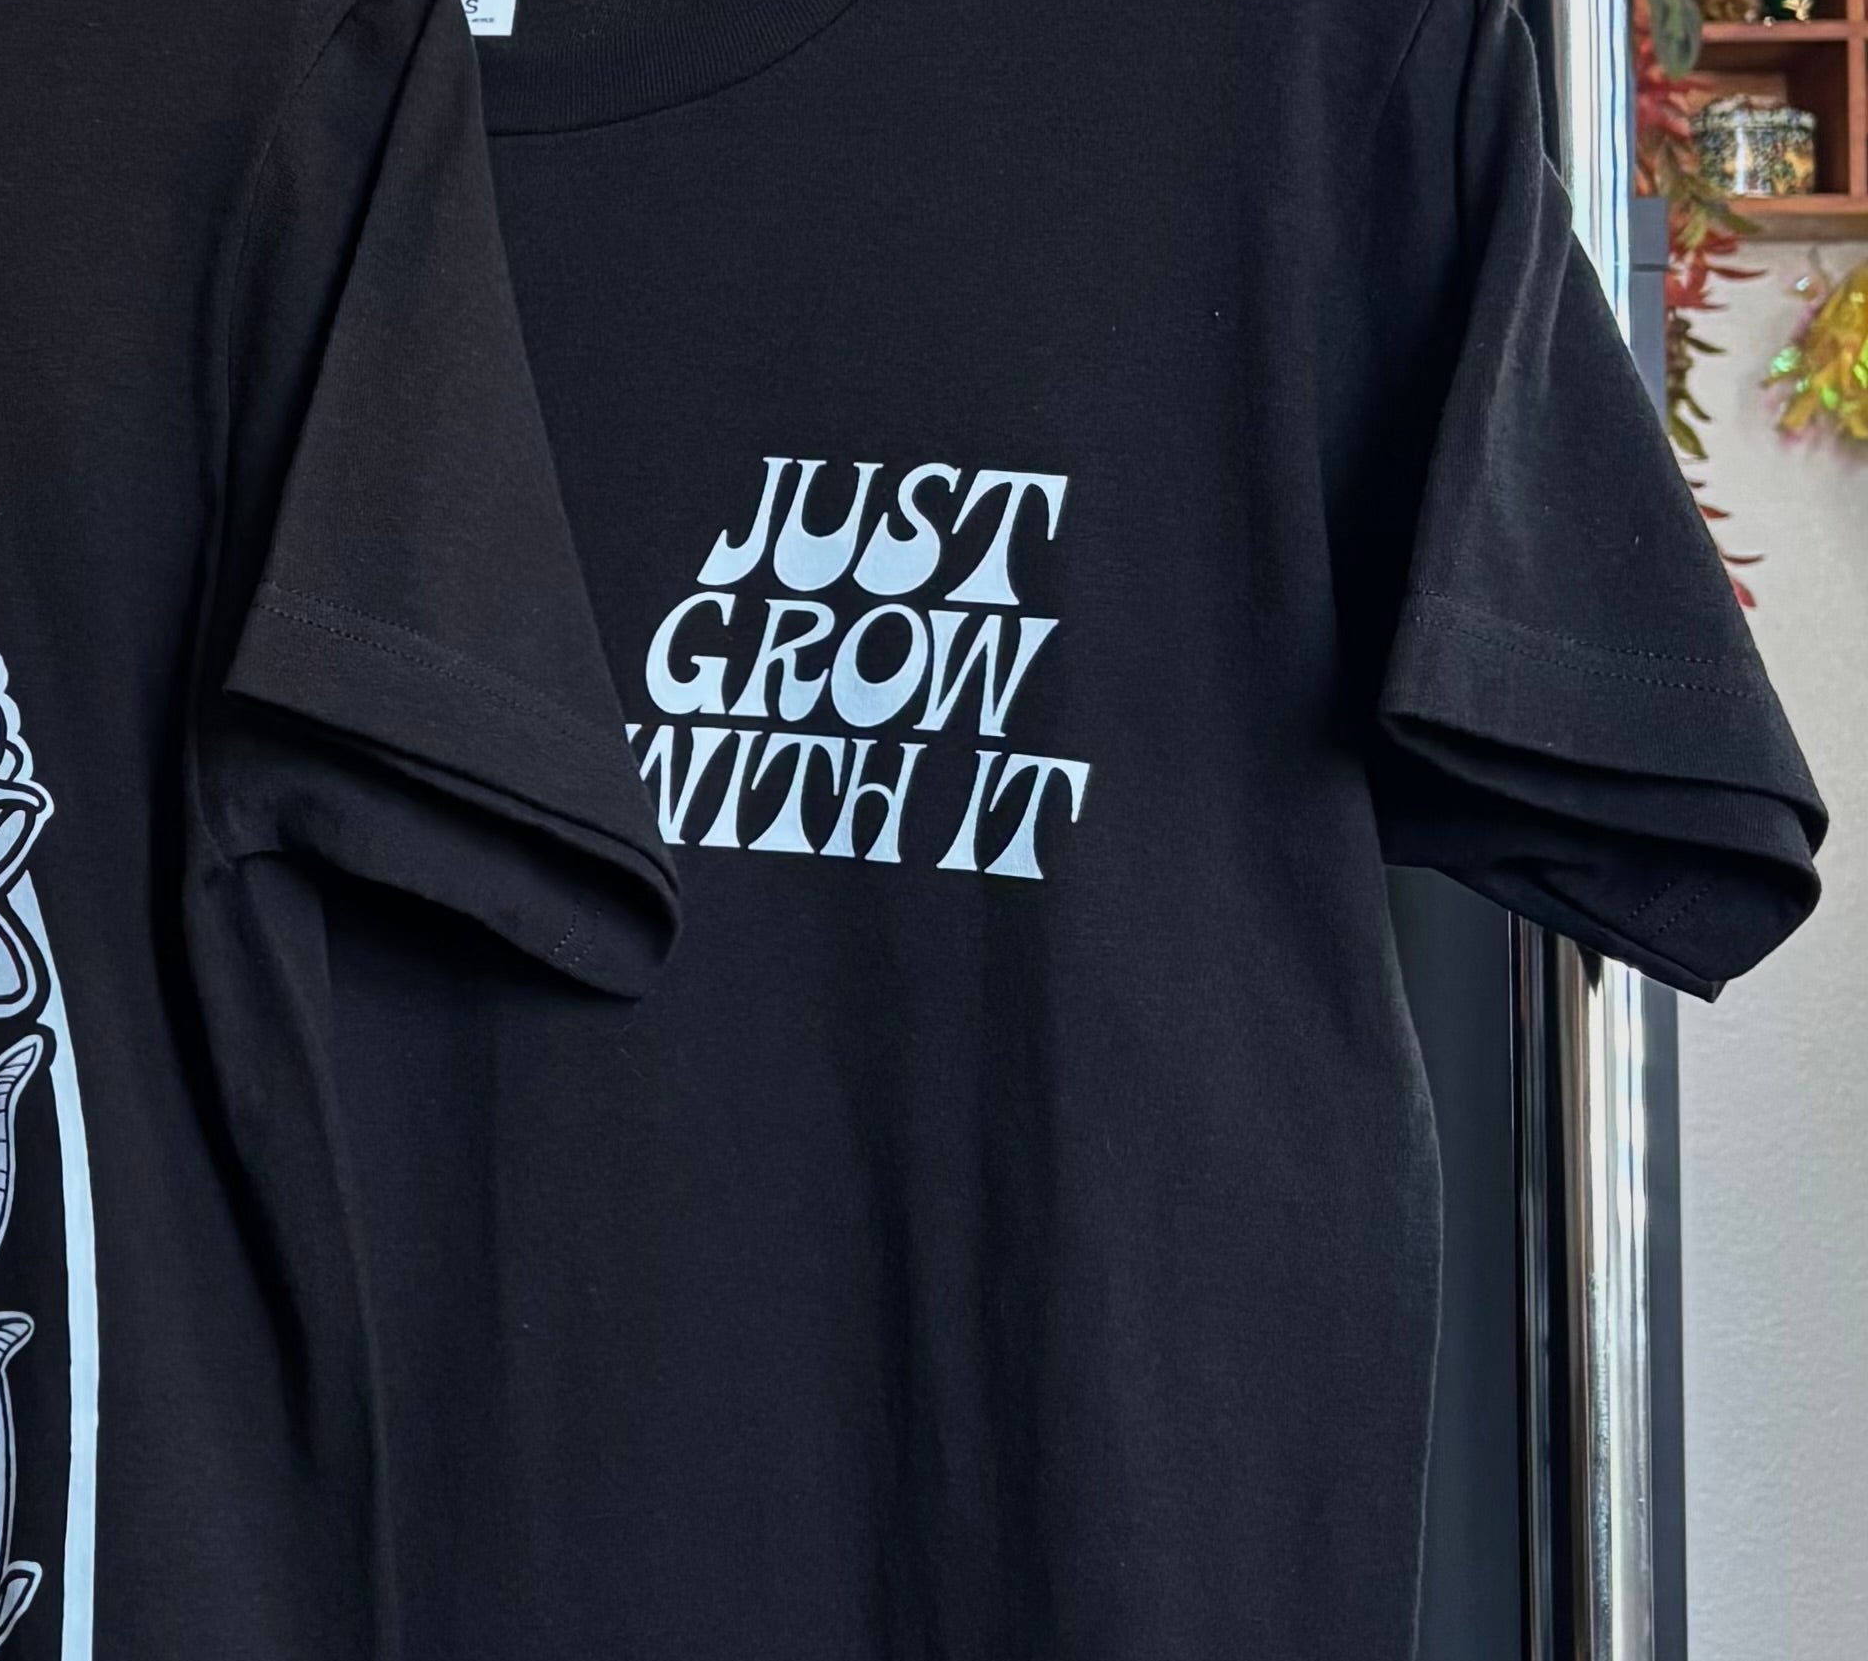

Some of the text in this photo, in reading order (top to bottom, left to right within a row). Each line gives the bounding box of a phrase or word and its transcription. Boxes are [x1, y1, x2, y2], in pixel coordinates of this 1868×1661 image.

[696, 456, 1068, 605] JUST
[645, 591, 1059, 737] GROW
[625, 723, 1091, 879] WITH IT
